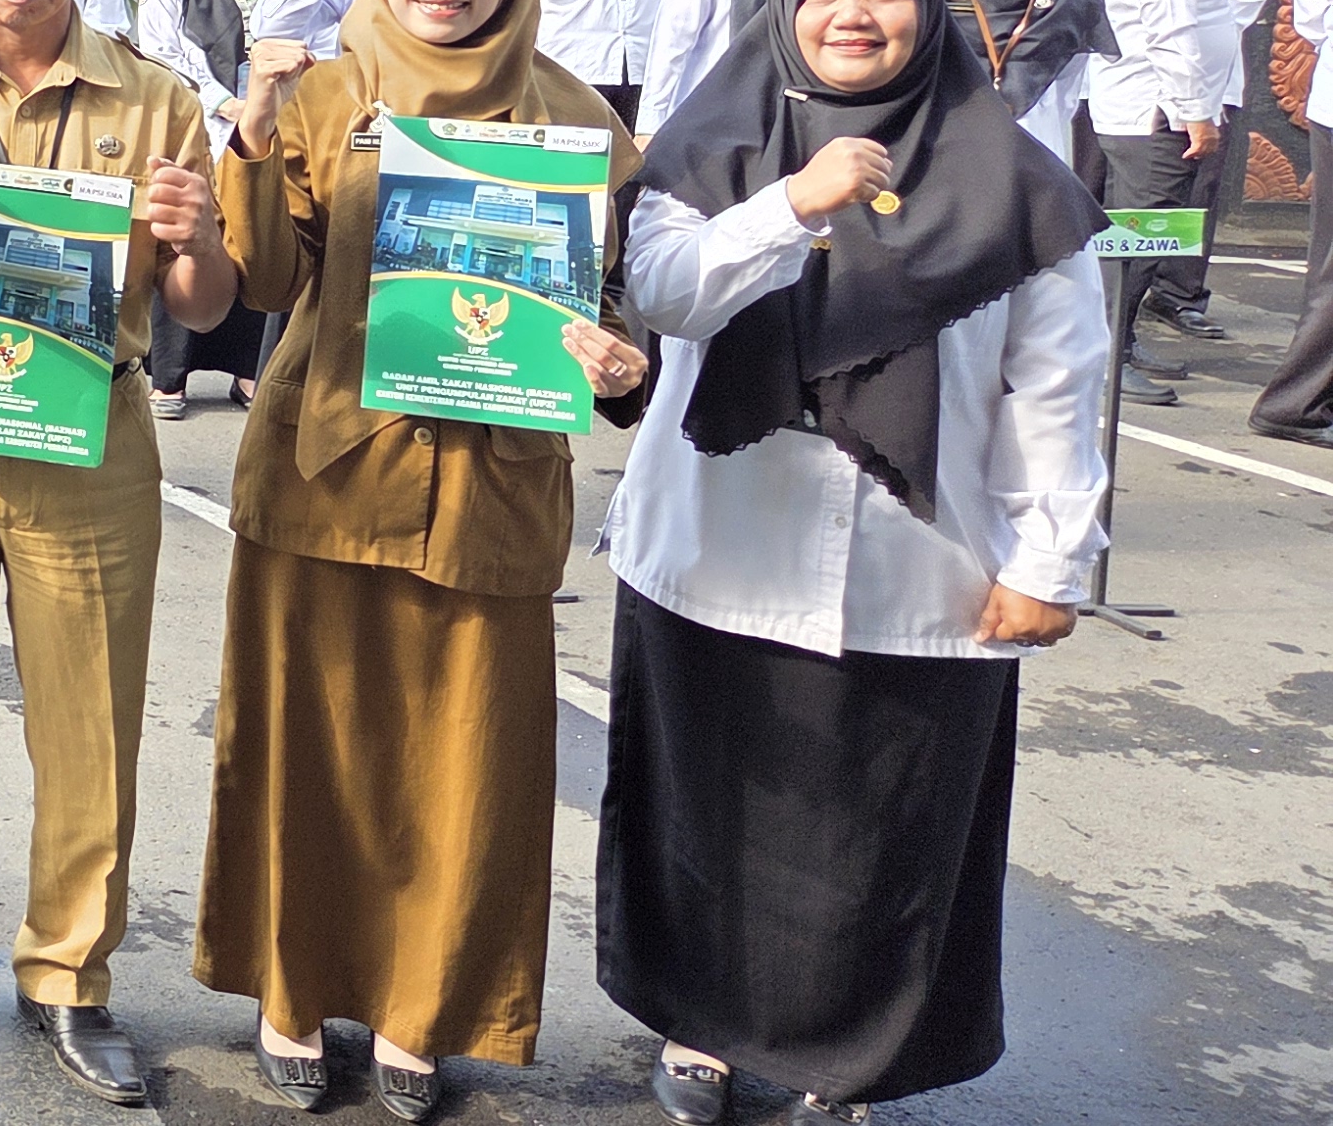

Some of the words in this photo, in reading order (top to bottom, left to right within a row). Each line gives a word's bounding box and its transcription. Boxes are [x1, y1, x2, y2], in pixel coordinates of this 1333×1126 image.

[1093, 239, 1114, 252] IS
[1119, 239, 1129, 252] &
[1135, 239, 1179, 251] ZAWA
